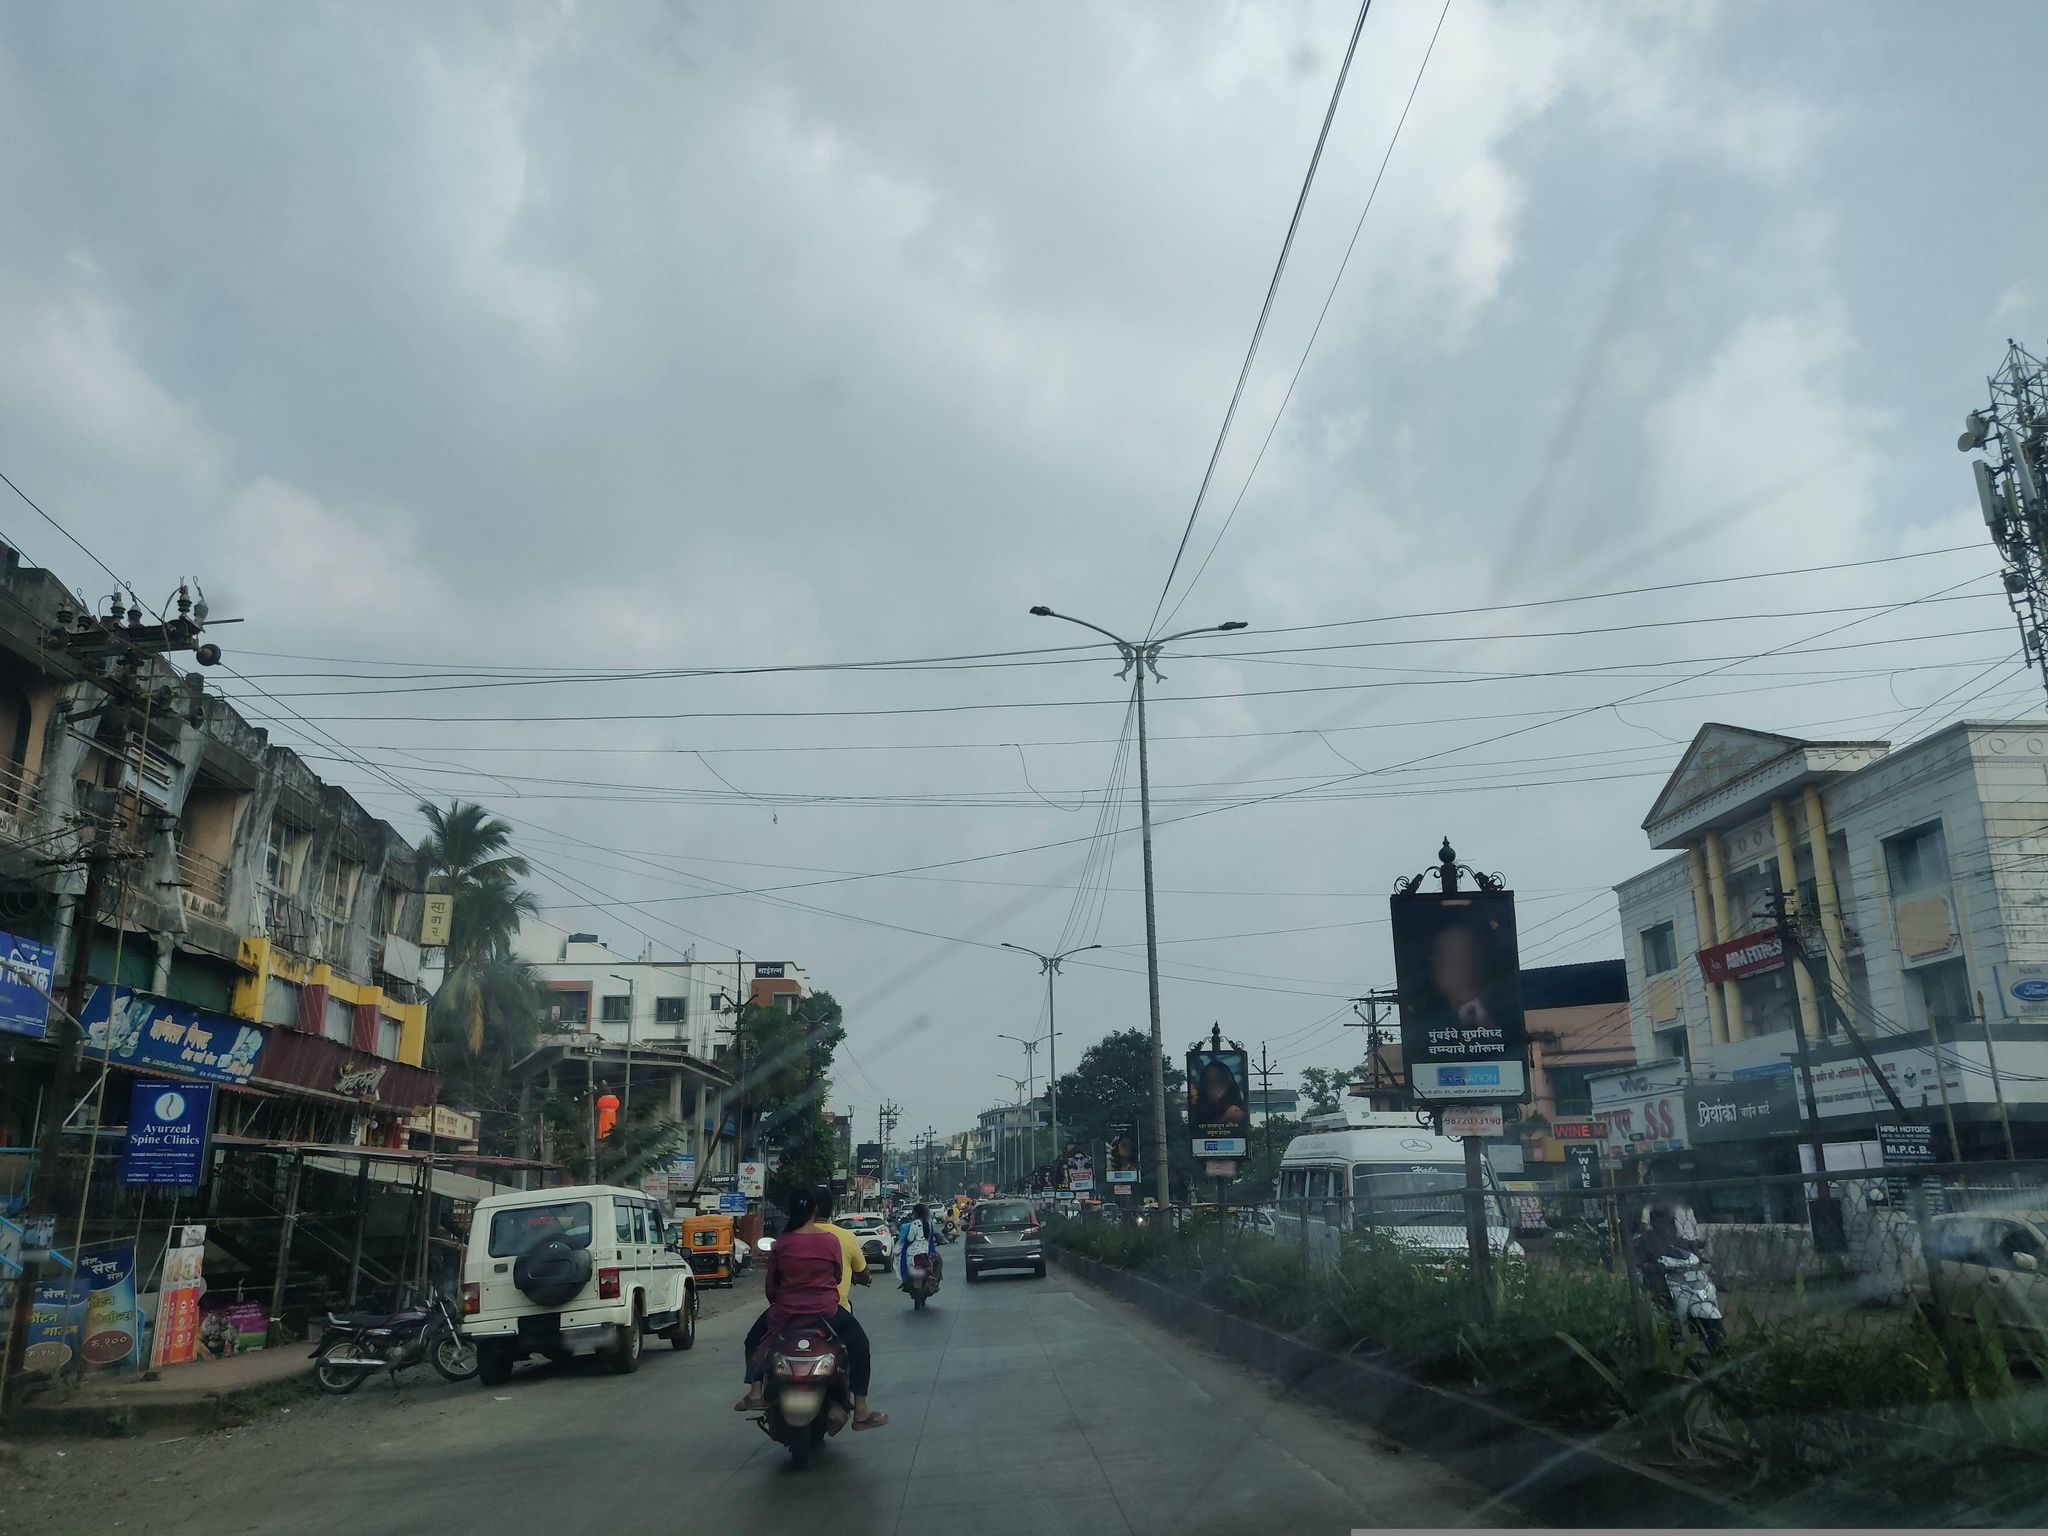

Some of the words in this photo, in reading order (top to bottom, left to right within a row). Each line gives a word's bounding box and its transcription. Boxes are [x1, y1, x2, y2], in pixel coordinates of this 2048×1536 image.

[143, 1124, 191, 1135] Ayurzeal
[1554, 1124, 1591, 1138] WINE
[1900, 1125, 1930, 1133] MOTORS
[130, 1134, 160, 1147] Spine
[163, 1134, 200, 1145] Clinics
[1886, 1145, 1931, 1154] M.P.C.B.
[1578, 1157, 1591, 1188] WINE
[91, 1260, 118, 1275] सेल
[43, 1287, 66, 1299] सेल
